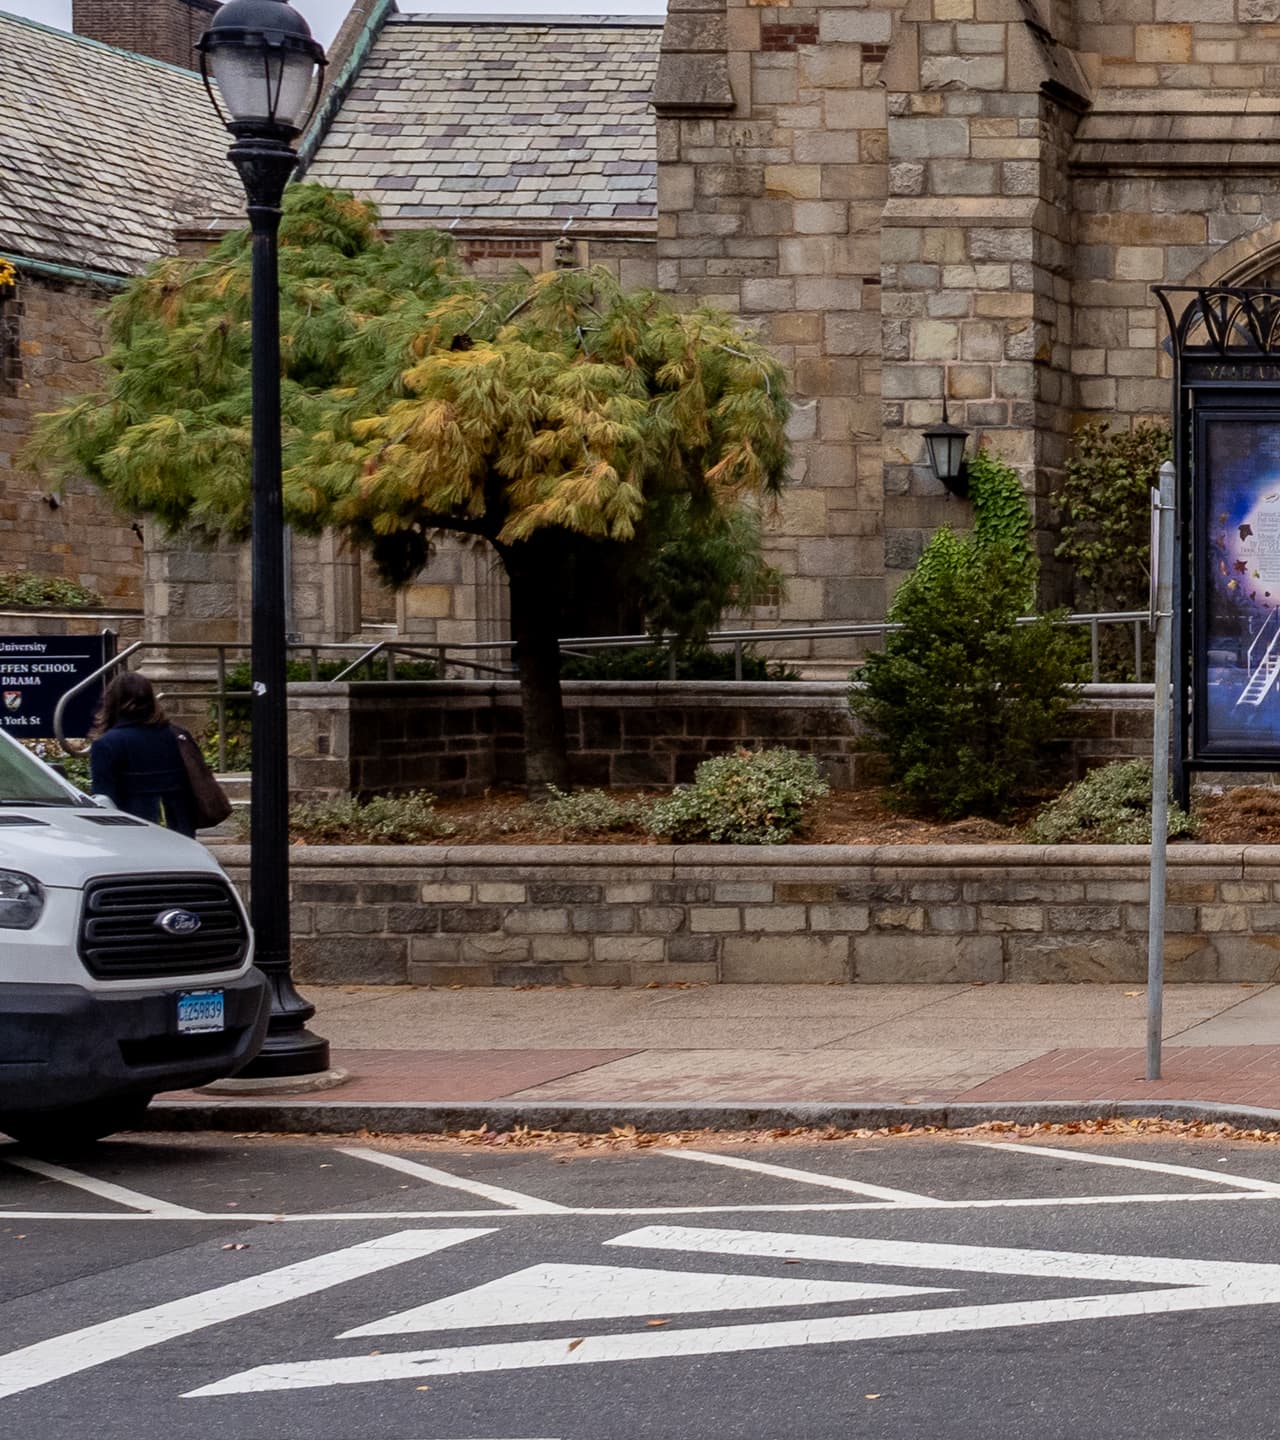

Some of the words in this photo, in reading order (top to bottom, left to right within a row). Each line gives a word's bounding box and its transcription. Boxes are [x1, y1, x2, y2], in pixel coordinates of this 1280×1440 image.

[31, 664, 77, 672] SCHOOL
[2, 676, 42, 685] DRAMA
[4, 716, 28, 725] York
[30, 716, 40, 725] St
[174, 914, 196, 929] Ford
